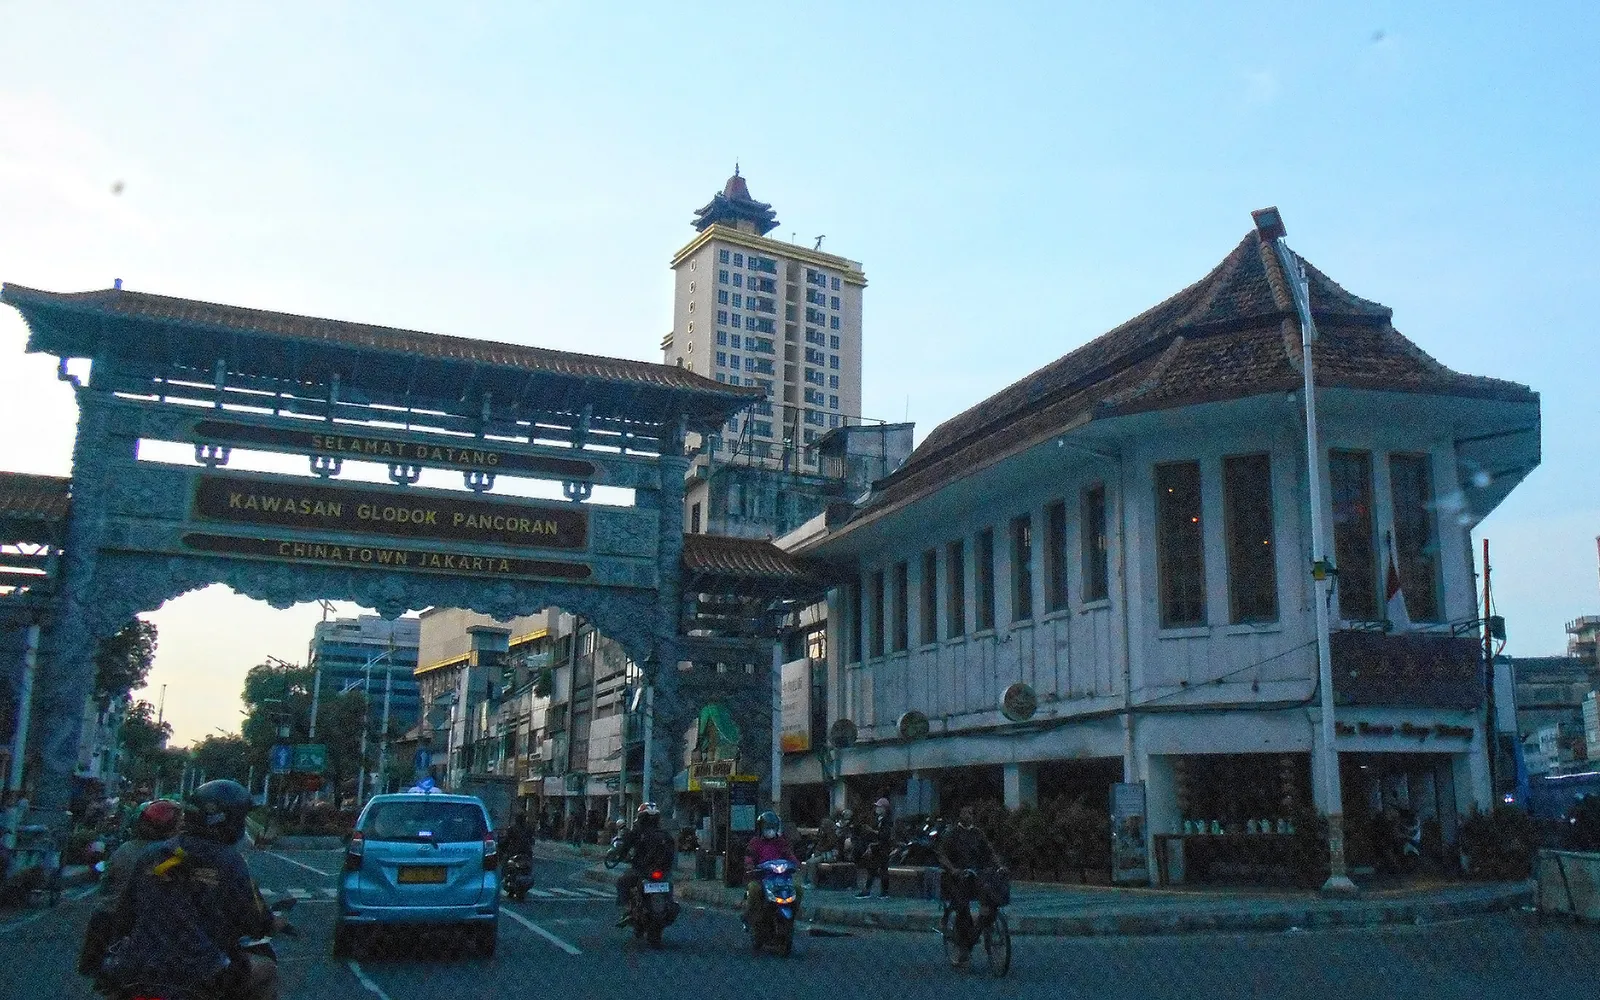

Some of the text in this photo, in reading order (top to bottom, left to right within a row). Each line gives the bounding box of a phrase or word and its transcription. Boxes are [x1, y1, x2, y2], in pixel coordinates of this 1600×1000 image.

[312, 436, 499, 465] SELAMAT DATANG
[229, 492, 558, 535] KAWASAN GLODOK PANCORAN
[279, 542, 510, 572] CHINATOWN JAKARTA
